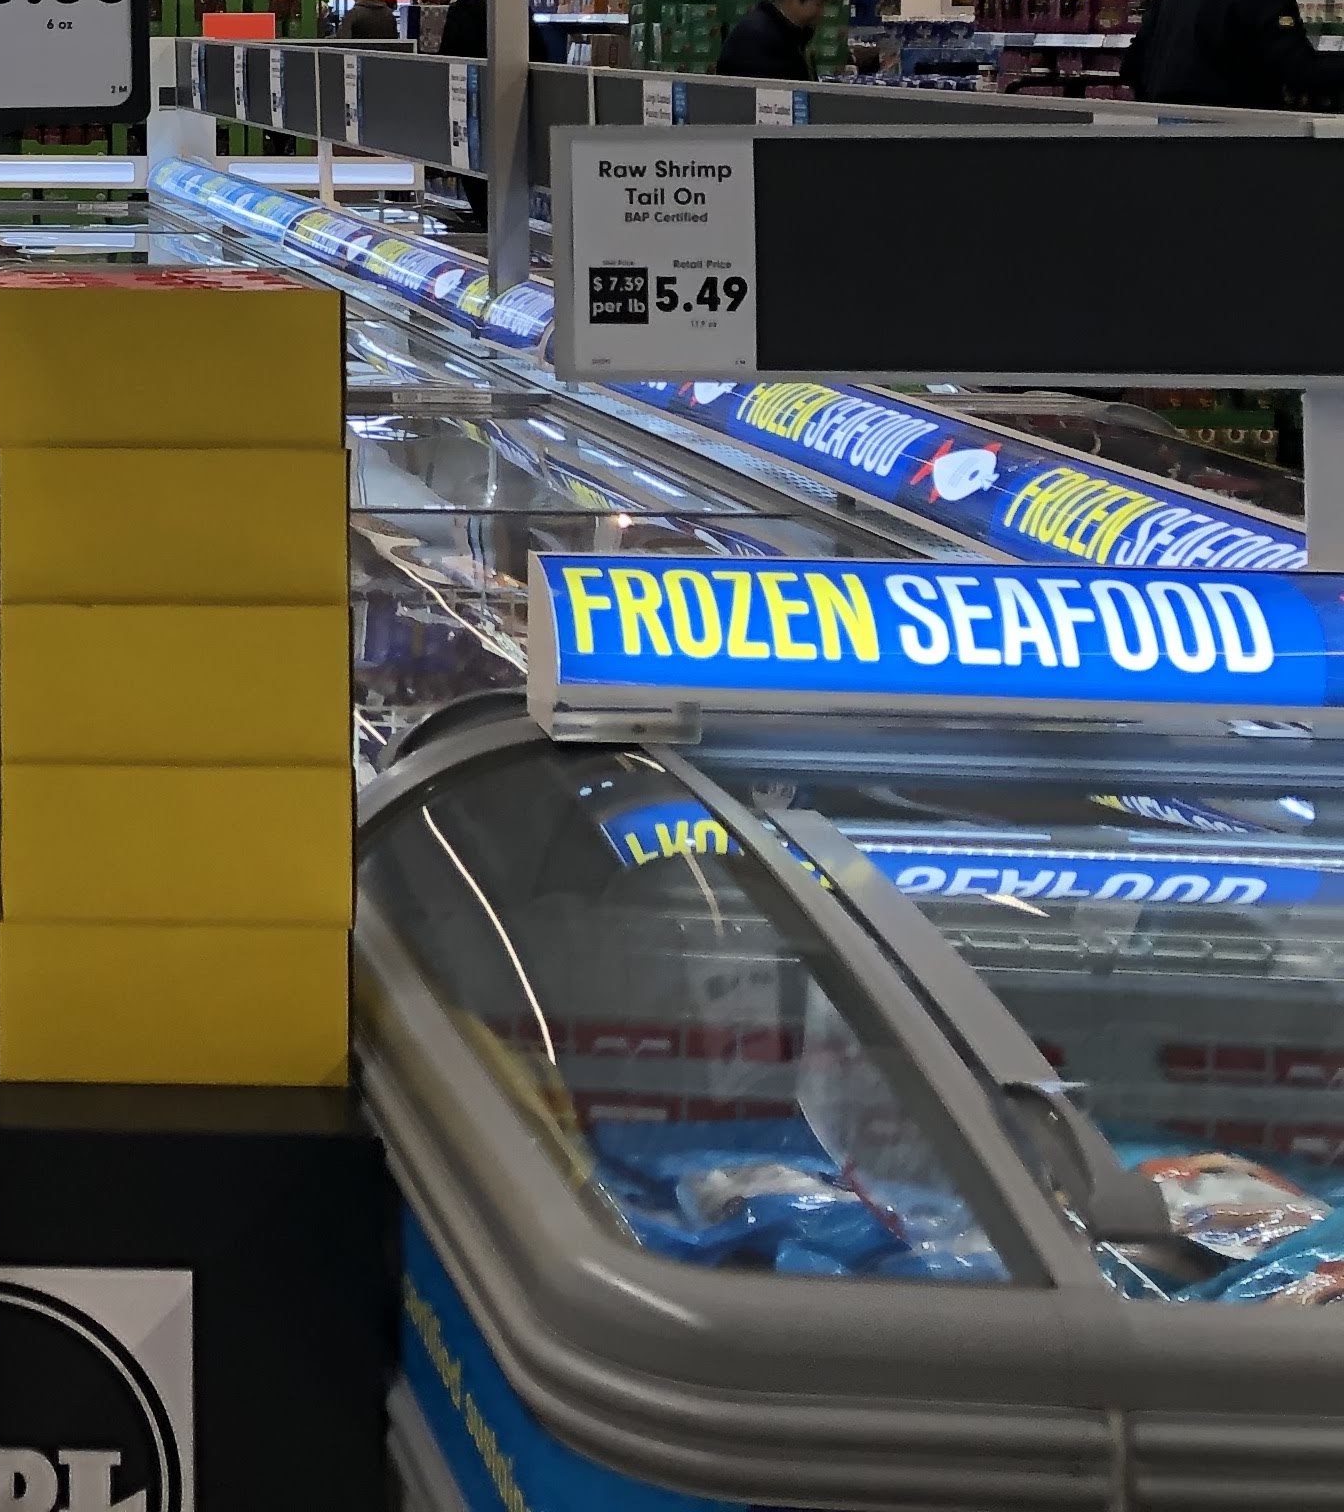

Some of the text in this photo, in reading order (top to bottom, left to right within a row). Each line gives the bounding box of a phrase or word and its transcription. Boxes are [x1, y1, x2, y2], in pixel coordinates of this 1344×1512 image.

[46, 19, 73, 30] 6 oz
[599, 160, 732, 182] Raw Shrimp
[625, 188, 706, 205] Tail On
[625, 212, 708, 223] BAP Certified
[673, 260, 732, 269] Retail Price
[593, 276, 644, 292] $ 7.39
[655, 276, 748, 312] 5.49
[592, 299, 646, 316] per lb
[736, 383, 940, 477] FROZEN SEAFOOD
[1003, 467, 1154, 565] FROZEN
[561, 566, 1275, 675] FROZEN SEAFOOD
